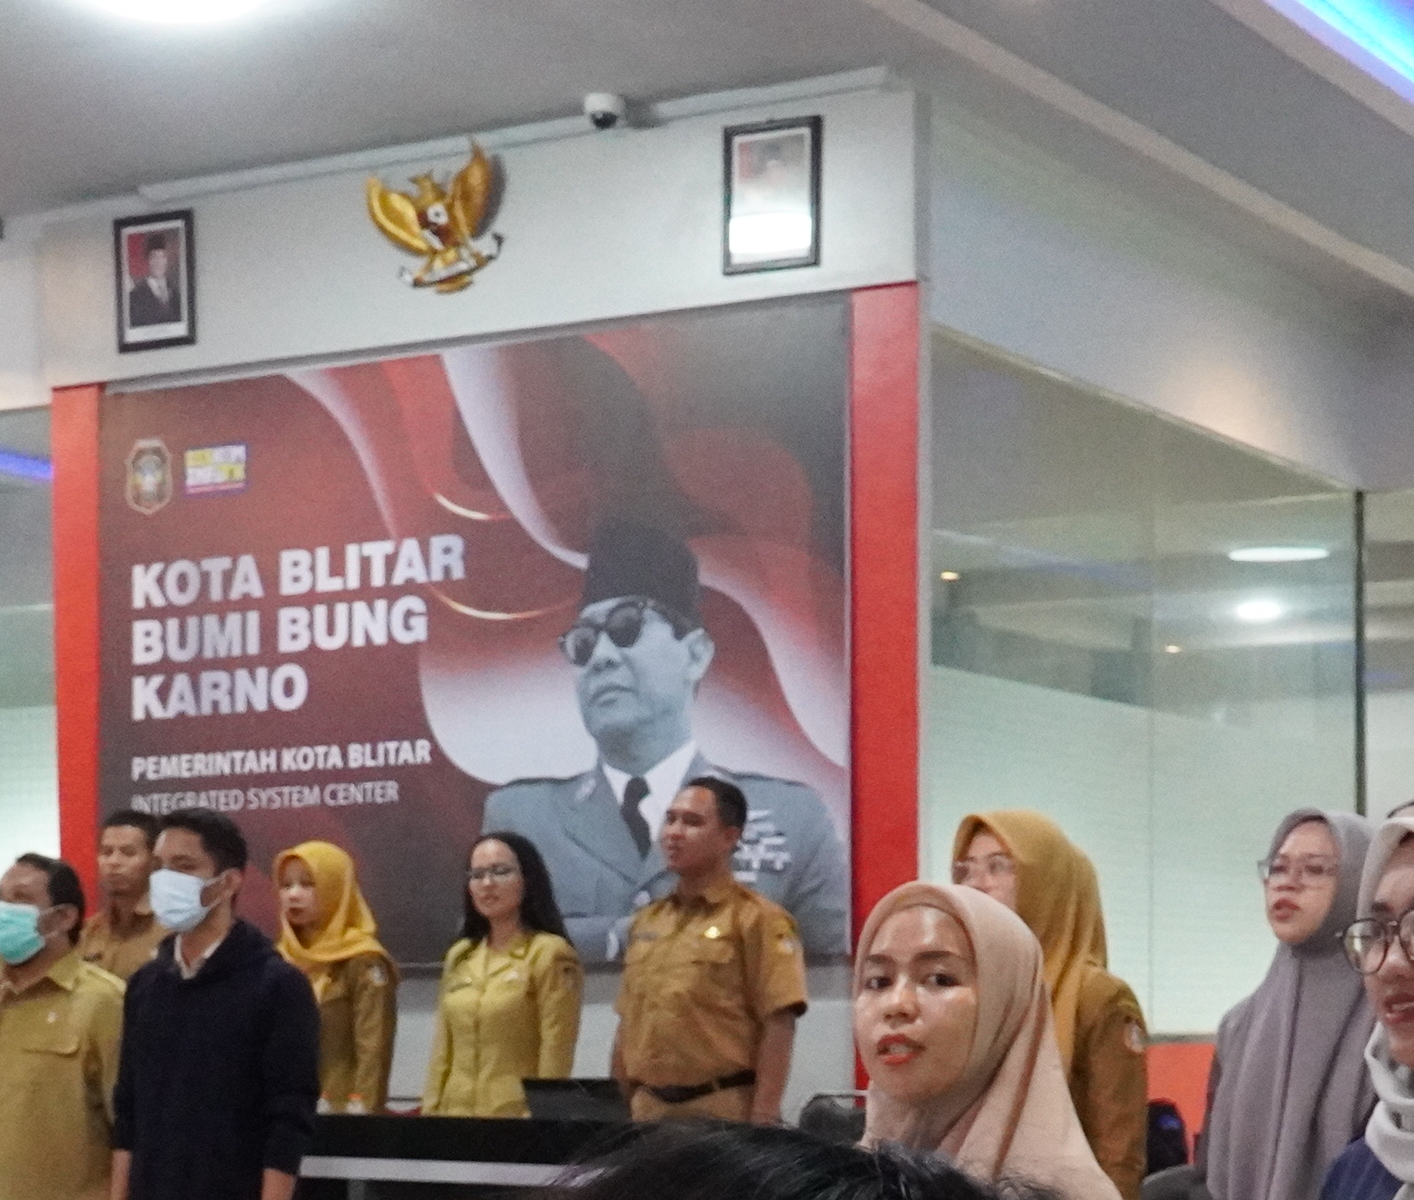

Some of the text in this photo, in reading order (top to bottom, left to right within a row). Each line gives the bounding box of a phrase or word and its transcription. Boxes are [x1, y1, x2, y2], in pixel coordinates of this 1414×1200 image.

[131, 534, 466, 609] KOTA BLITAR
[131, 596, 428, 665] BUMI BUNG
[131, 664, 308, 721] KARNO
[131, 739, 432, 782] PEMERINTAH KOTA BLITAR
[130, 780, 400, 816] INTEGRATED SYSTEM CENTER
